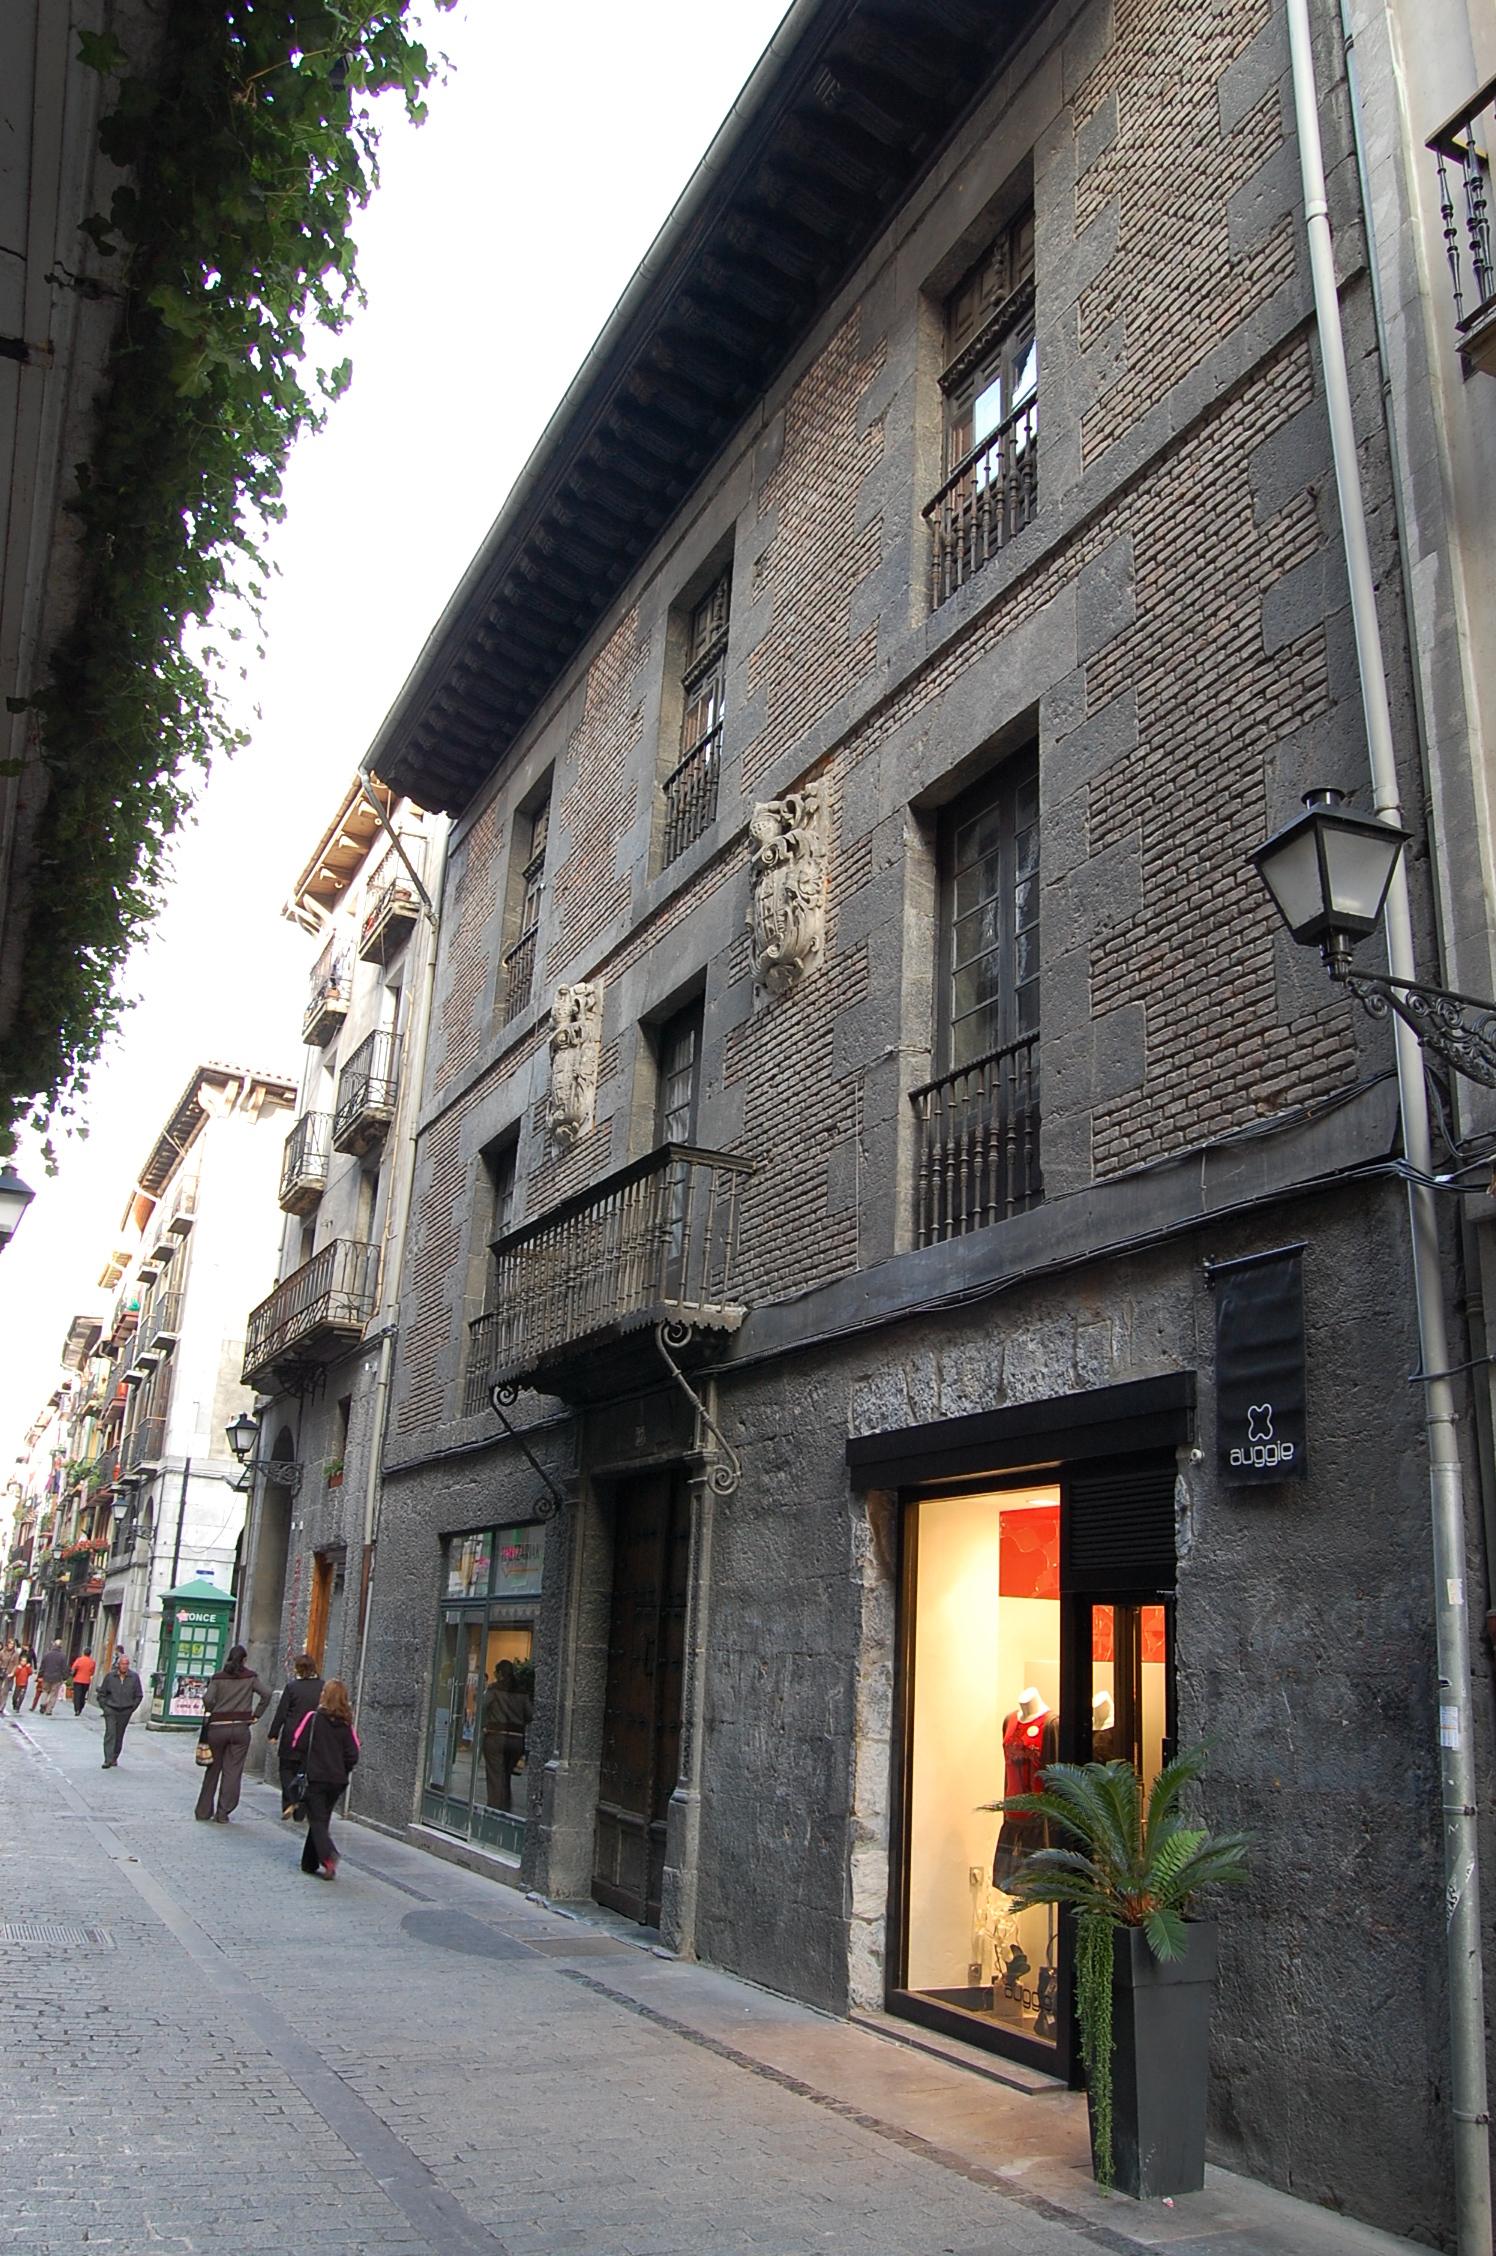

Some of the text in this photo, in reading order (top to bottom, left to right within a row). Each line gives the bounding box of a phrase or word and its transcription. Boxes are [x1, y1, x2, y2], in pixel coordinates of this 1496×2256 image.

[1230, 1440, 1294, 1467] auggie
[189, 1613, 217, 1623] ONCE
[1004, 1984, 1052, 2012] augge
